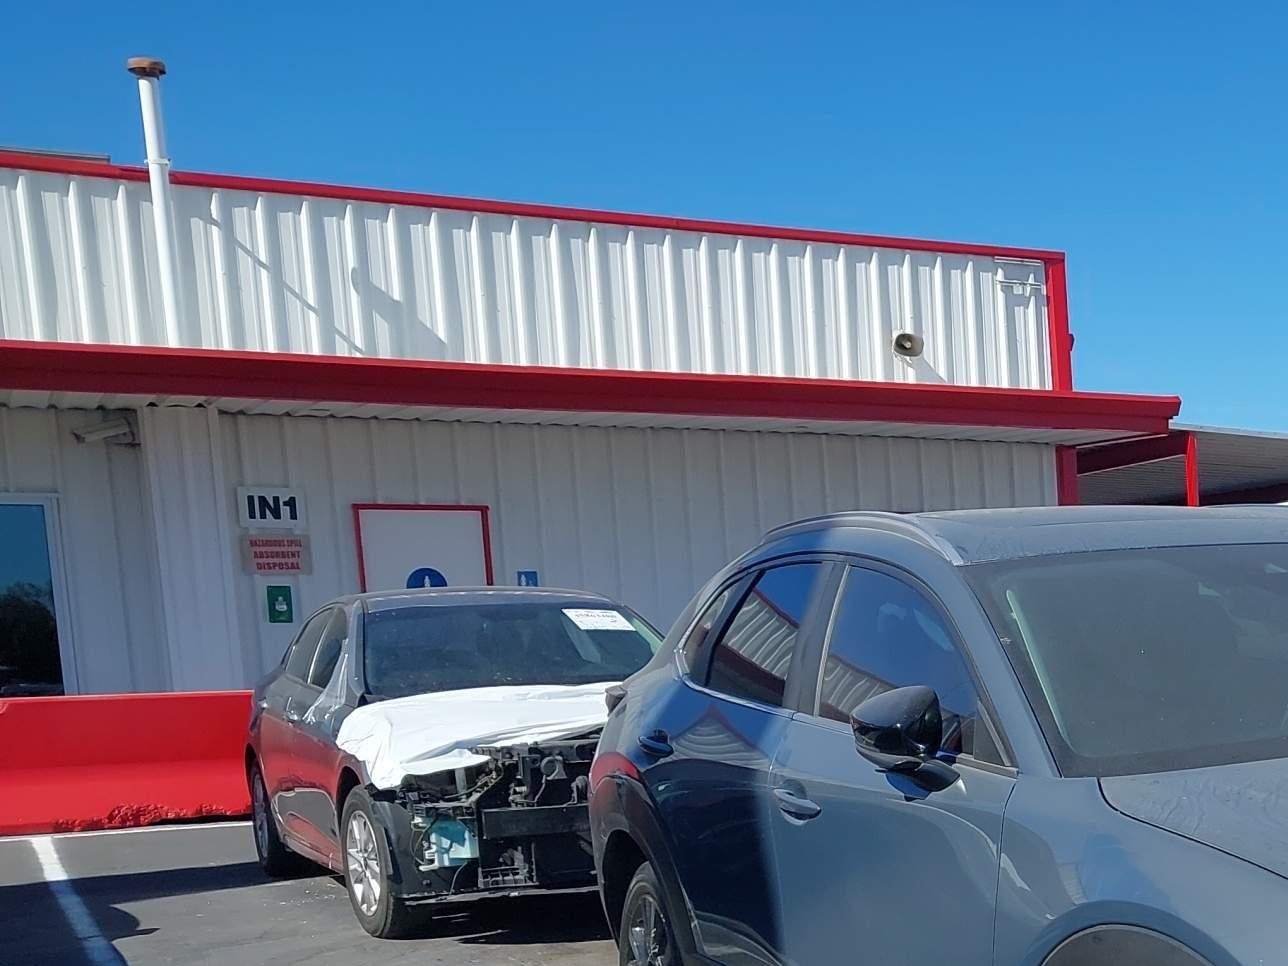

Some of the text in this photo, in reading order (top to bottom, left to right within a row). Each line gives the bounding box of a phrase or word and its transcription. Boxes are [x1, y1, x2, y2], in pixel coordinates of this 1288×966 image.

[247, 494, 298, 521] IN1
[253, 551, 301, 559] ABSORBENT
[256, 562, 302, 570] DISPOSAL
